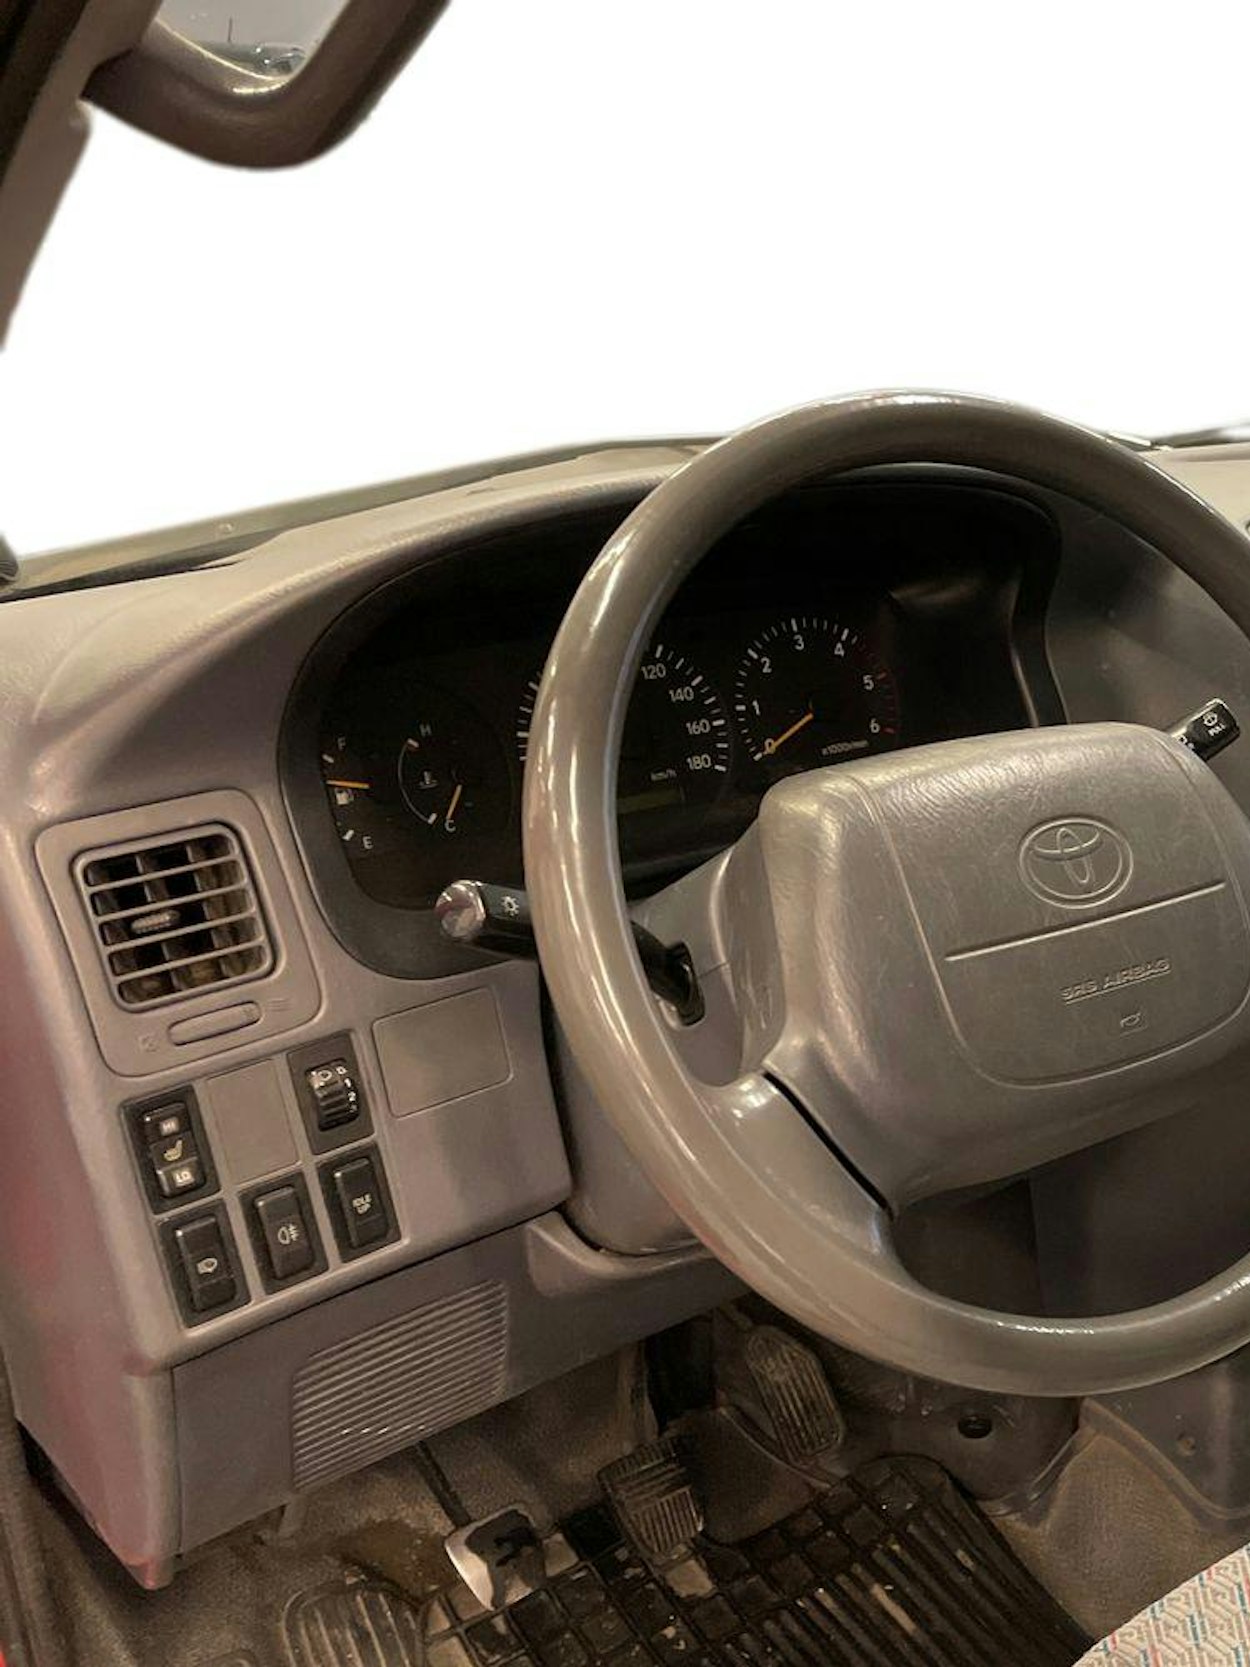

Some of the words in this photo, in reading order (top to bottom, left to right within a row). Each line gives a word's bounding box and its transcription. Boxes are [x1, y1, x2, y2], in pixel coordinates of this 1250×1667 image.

[793, 634, 805, 651] 3
[833, 642, 845, 657] 4
[641, 663, 667, 680] 120
[760, 657, 772, 673] 2
[863, 675, 875, 690] 5
[668, 686, 695, 702] 140
[752, 700, 761, 716] 1
[419, 724, 432, 737] H
[685, 719, 711, 735] 160
[869, 718, 881, 733] 6
[336, 736, 346, 751] F
[686, 753, 712, 770] 180
[444, 819, 456, 832] C
[363, 836, 373, 850] E
[1103, 958, 1170, 989] AIRBAG
[344, 1077, 352, 1088] 1
[347, 1091, 357, 1102] 2
